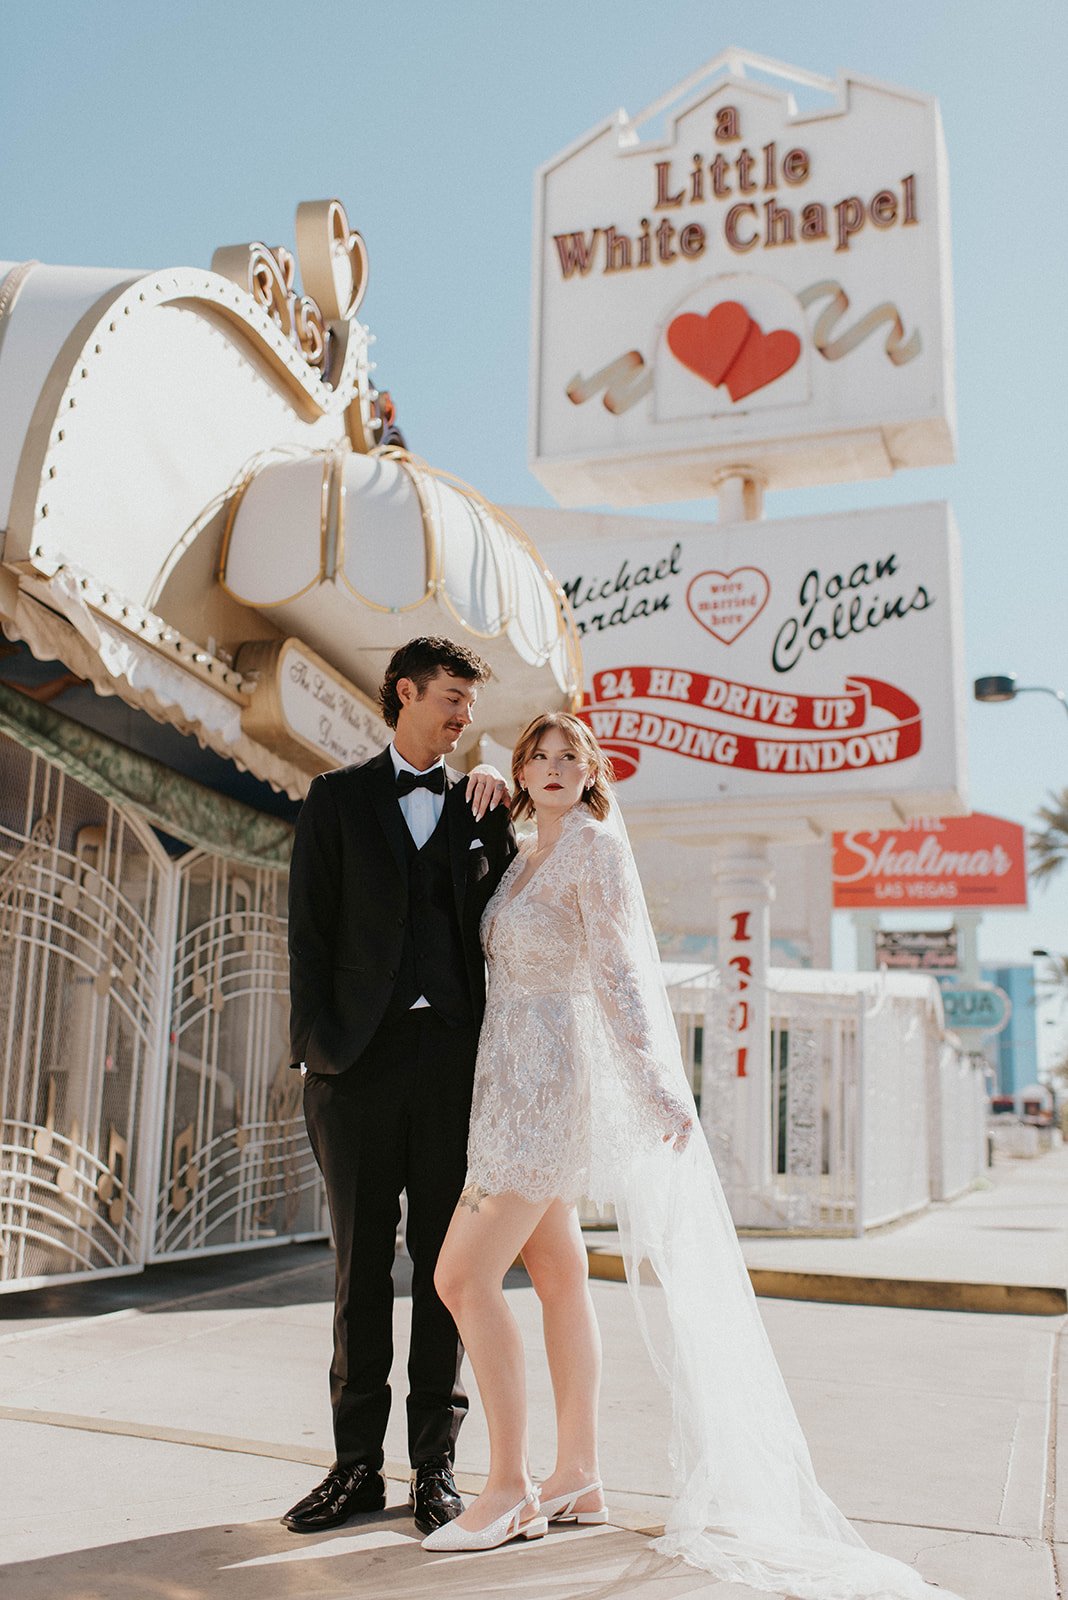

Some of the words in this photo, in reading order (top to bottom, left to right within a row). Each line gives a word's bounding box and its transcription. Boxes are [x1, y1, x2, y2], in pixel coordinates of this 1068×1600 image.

[715, 105, 740, 143] a
[654, 142, 811, 210] Little
[553, 217, 706, 279] White
[725, 173, 918, 252] Chapel
[560, 543, 682, 609] Michael
[698, 595, 757, 611] married
[799, 552, 900, 627] Joan
[711, 614, 742, 625] here
[772, 584, 937, 673] Collins
[600, 670, 635, 699] 24
[646, 669, 694, 701] HR
[703, 678, 799, 726] DRIVE
[812, 698, 857, 729] UP
[589, 711, 739, 765] WEDDING
[754, 729, 900, 772] WINDOW
[832, 829, 1012, 883] Shalimar
[874, 882, 902, 899] LAS
[906, 880, 958, 899] VEGAS
[943, 993, 996, 1016] QUA
